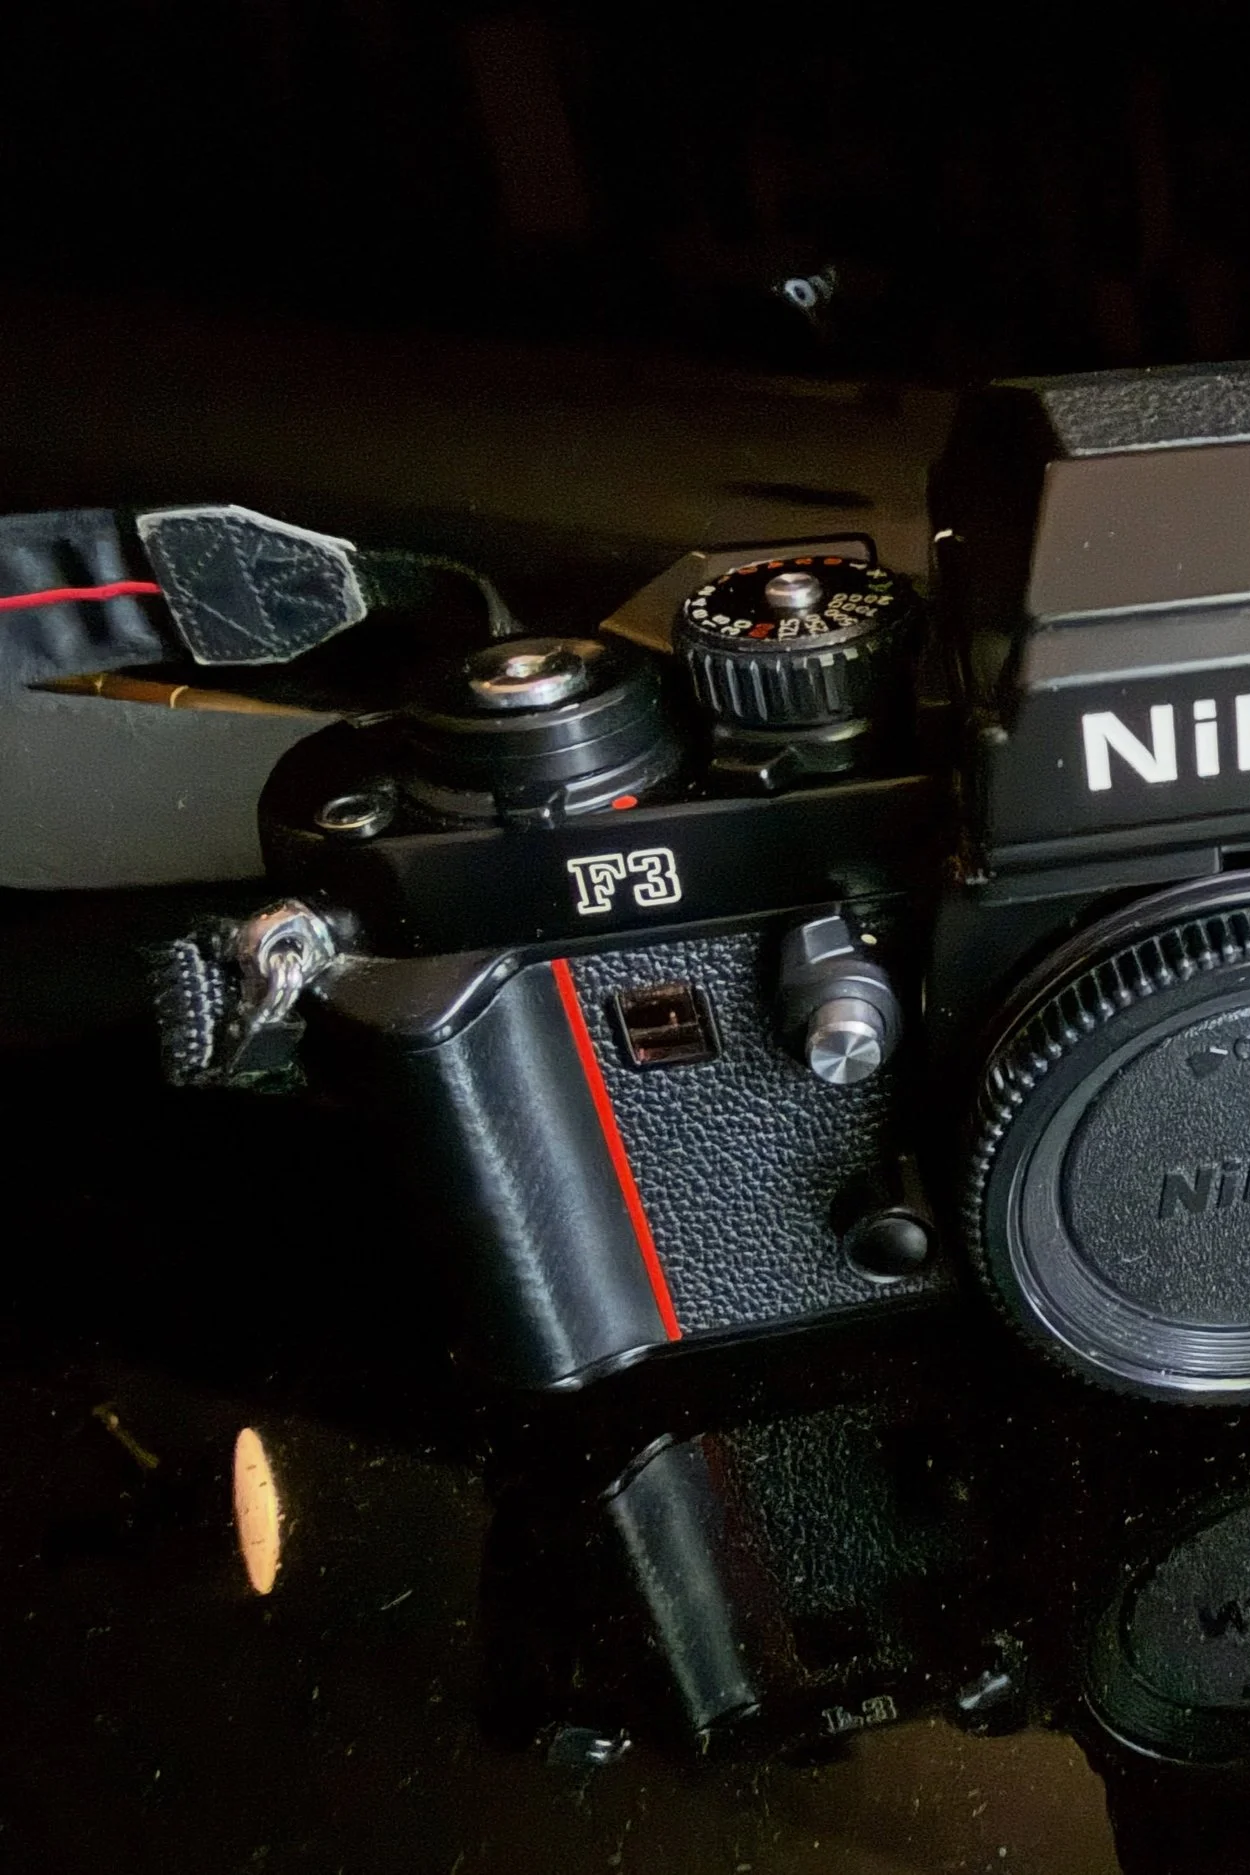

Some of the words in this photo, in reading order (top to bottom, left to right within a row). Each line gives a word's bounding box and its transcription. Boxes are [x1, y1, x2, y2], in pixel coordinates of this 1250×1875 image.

[827, 599, 878, 618] 1000
[832, 592, 894, 606] 2000
[720, 618, 753, 636] 30
[824, 608, 858, 627] 500
[778, 617, 800, 642] 125
[567, 847, 682, 915] F3
